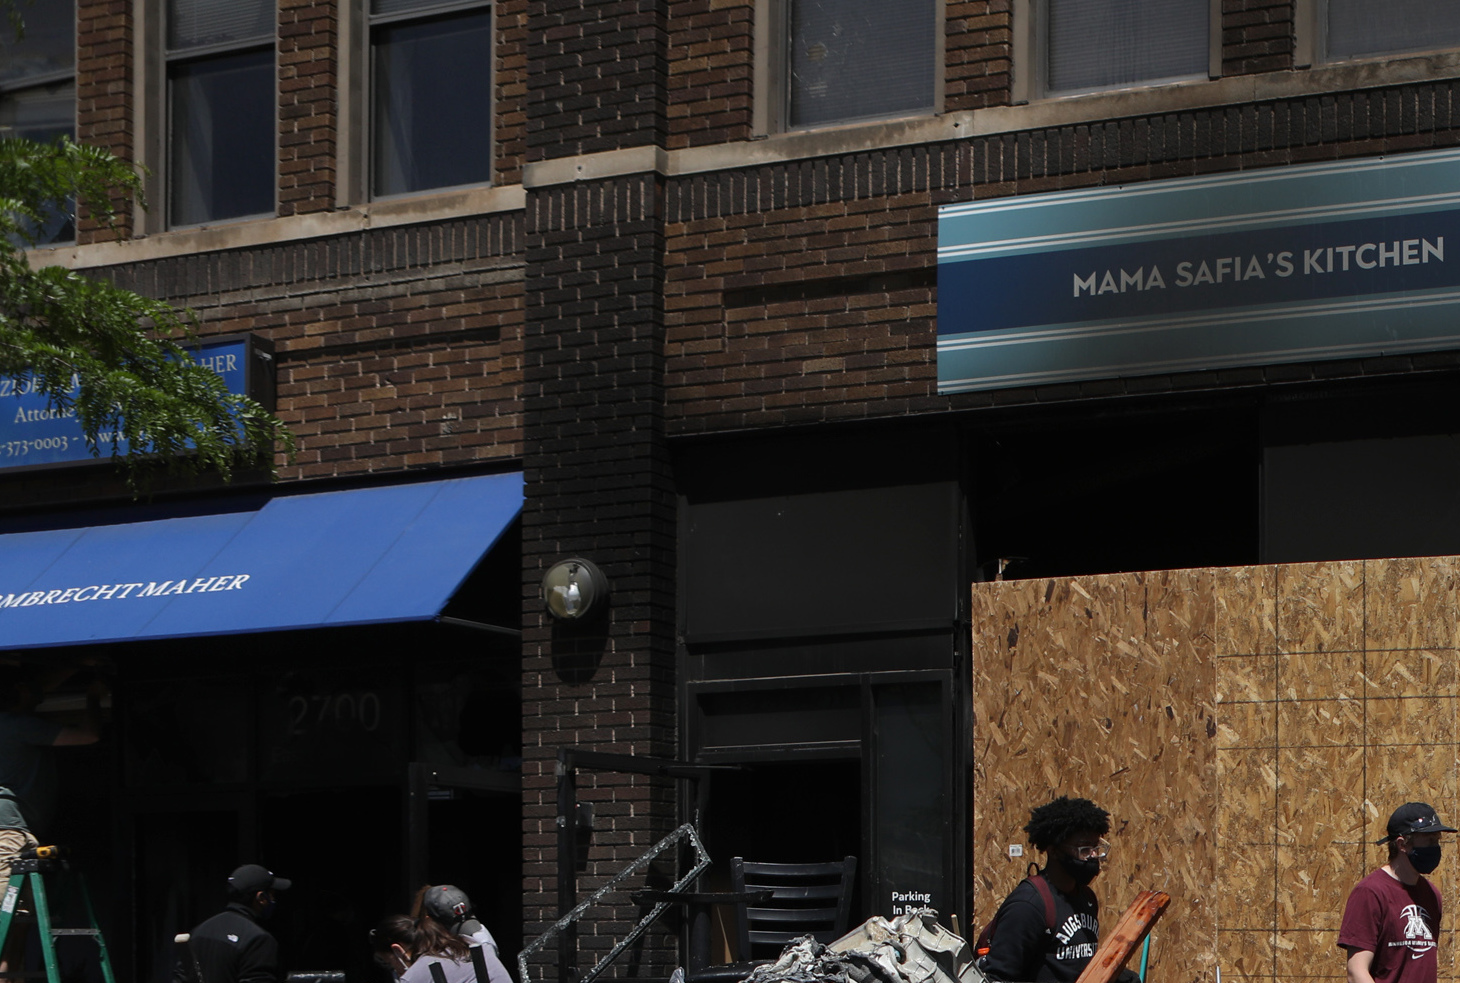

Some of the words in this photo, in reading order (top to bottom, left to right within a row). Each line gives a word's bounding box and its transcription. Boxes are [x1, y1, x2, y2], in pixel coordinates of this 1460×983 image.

[1073, 264, 1166, 298] MAMA
[1174, 251, 1294, 287] SAFIA'S
[1303, 236, 1444, 275] KITCHEN
[14, 406, 80, 424] Attorne
[0, 436, 69, 457] -373-0003
[136, 574, 251, 598] MAHER
[289, 692, 380, 735] 2700
[891, 890, 931, 903] Parking
[892, 904, 903, 915] In
[1056, 942, 1098, 960] UNIVERSIT
